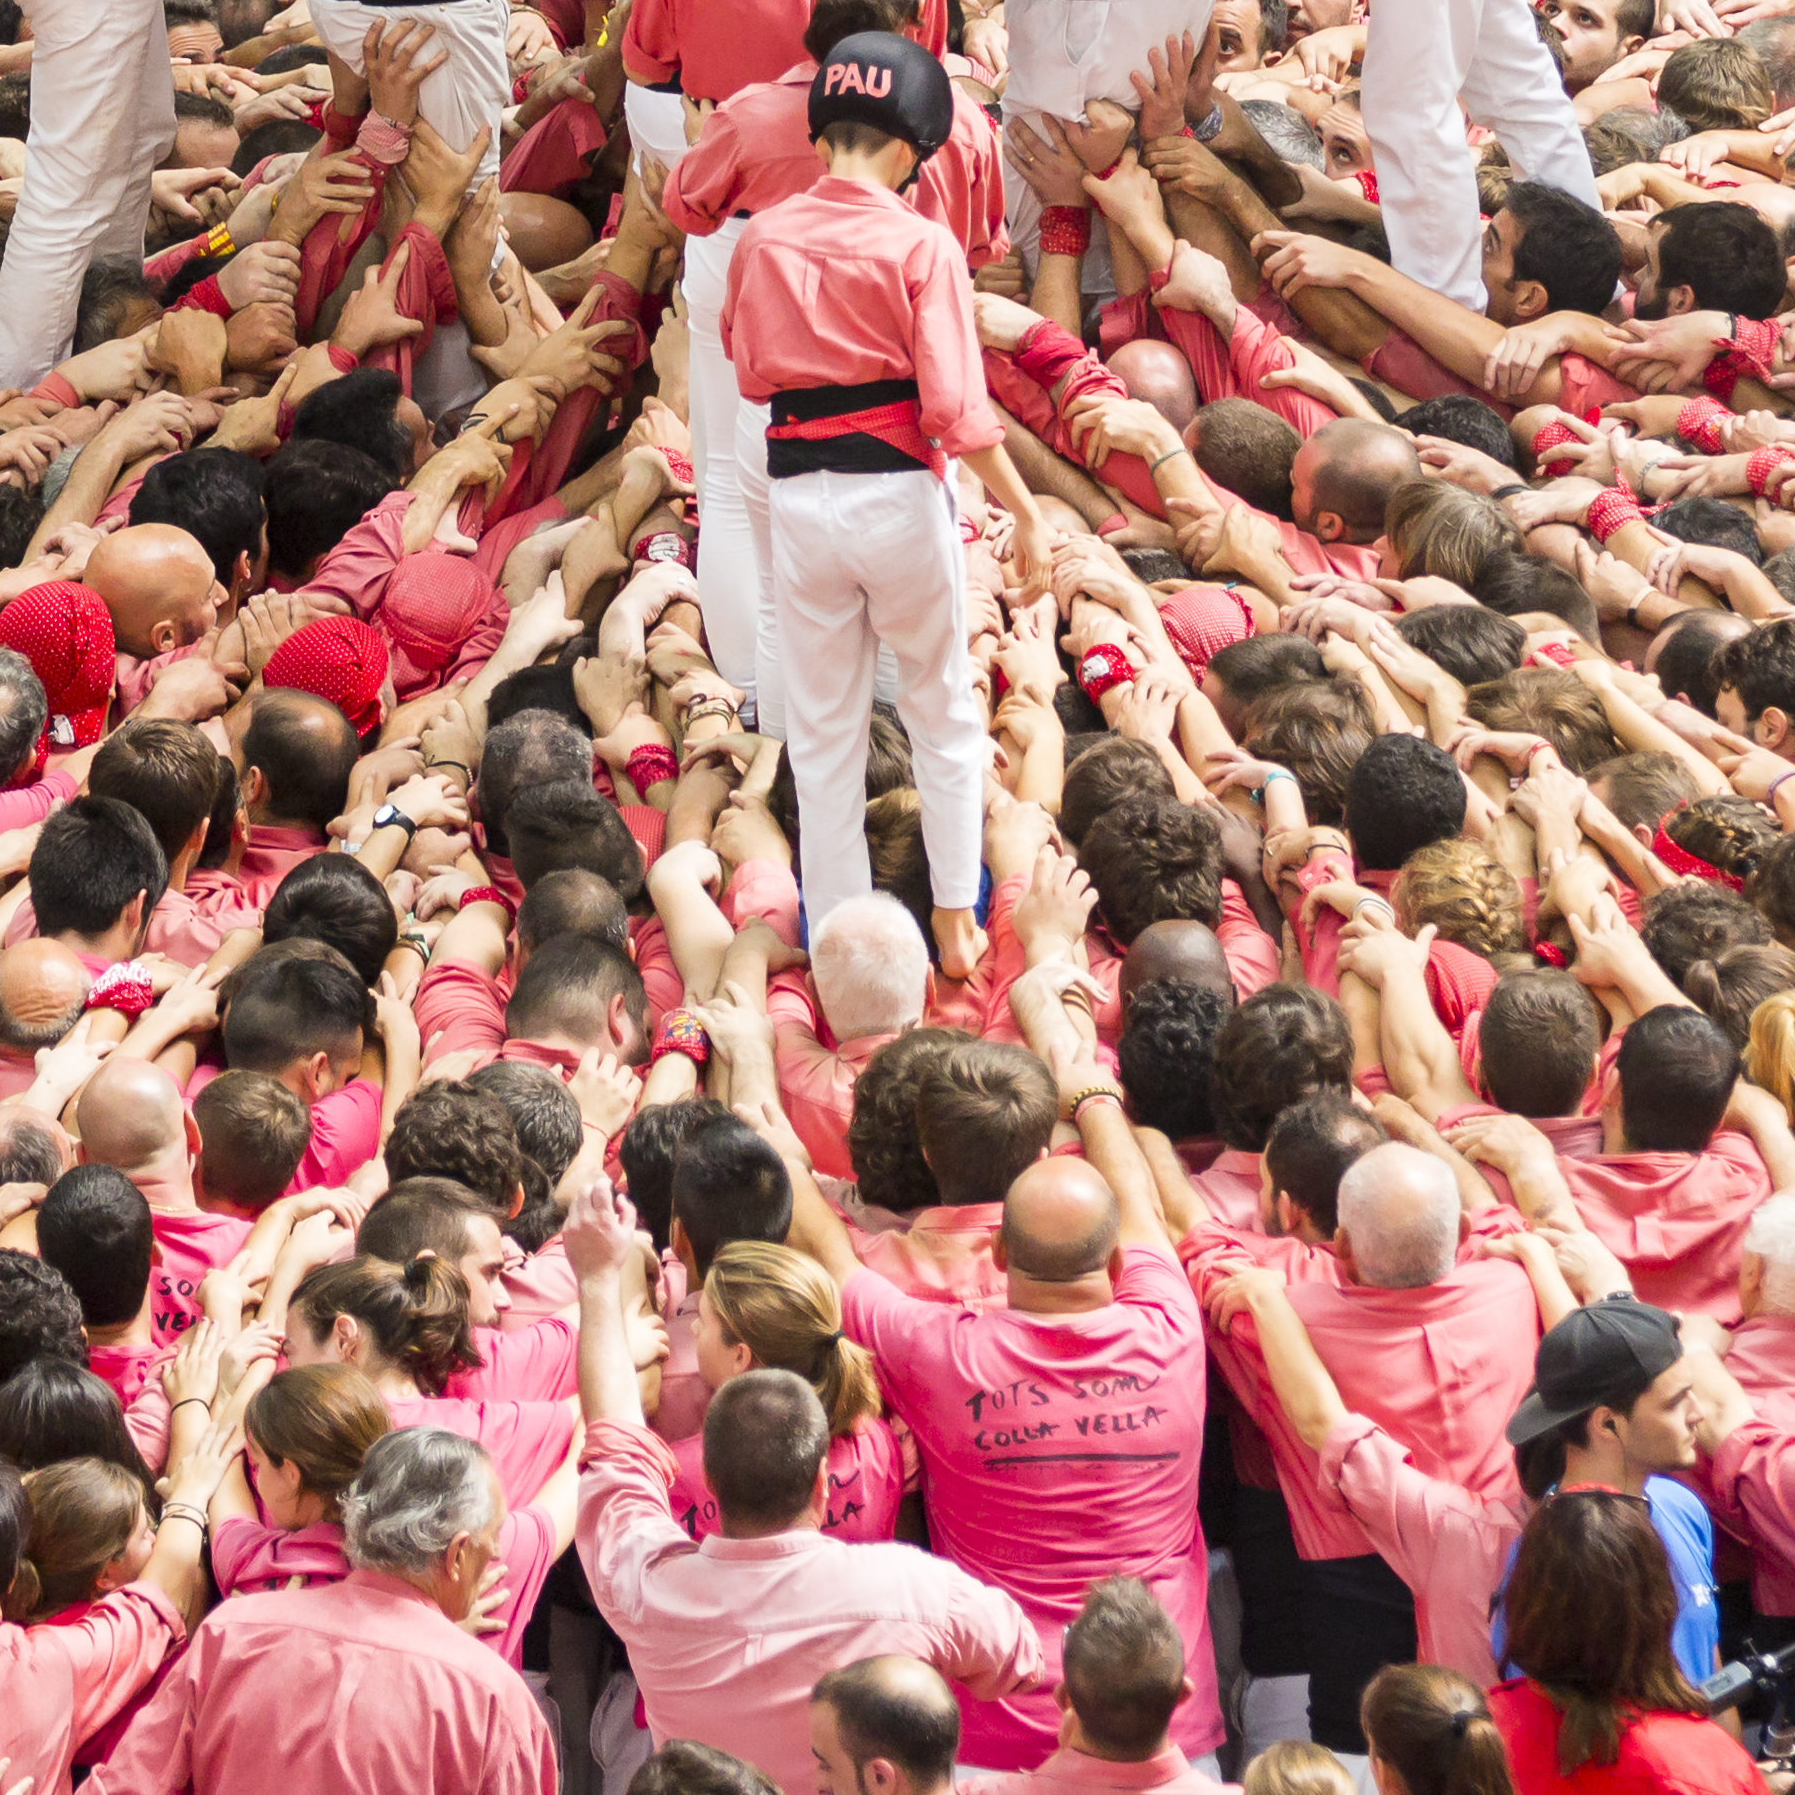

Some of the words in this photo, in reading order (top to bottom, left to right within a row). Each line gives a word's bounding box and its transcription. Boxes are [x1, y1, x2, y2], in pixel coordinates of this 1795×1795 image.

[823, 62, 892, 99] PAU
[965, 1378, 1050, 1423] TOTS
[973, 1421, 1061, 1452] COLLA
[1074, 1405, 1169, 1437] VELLA
